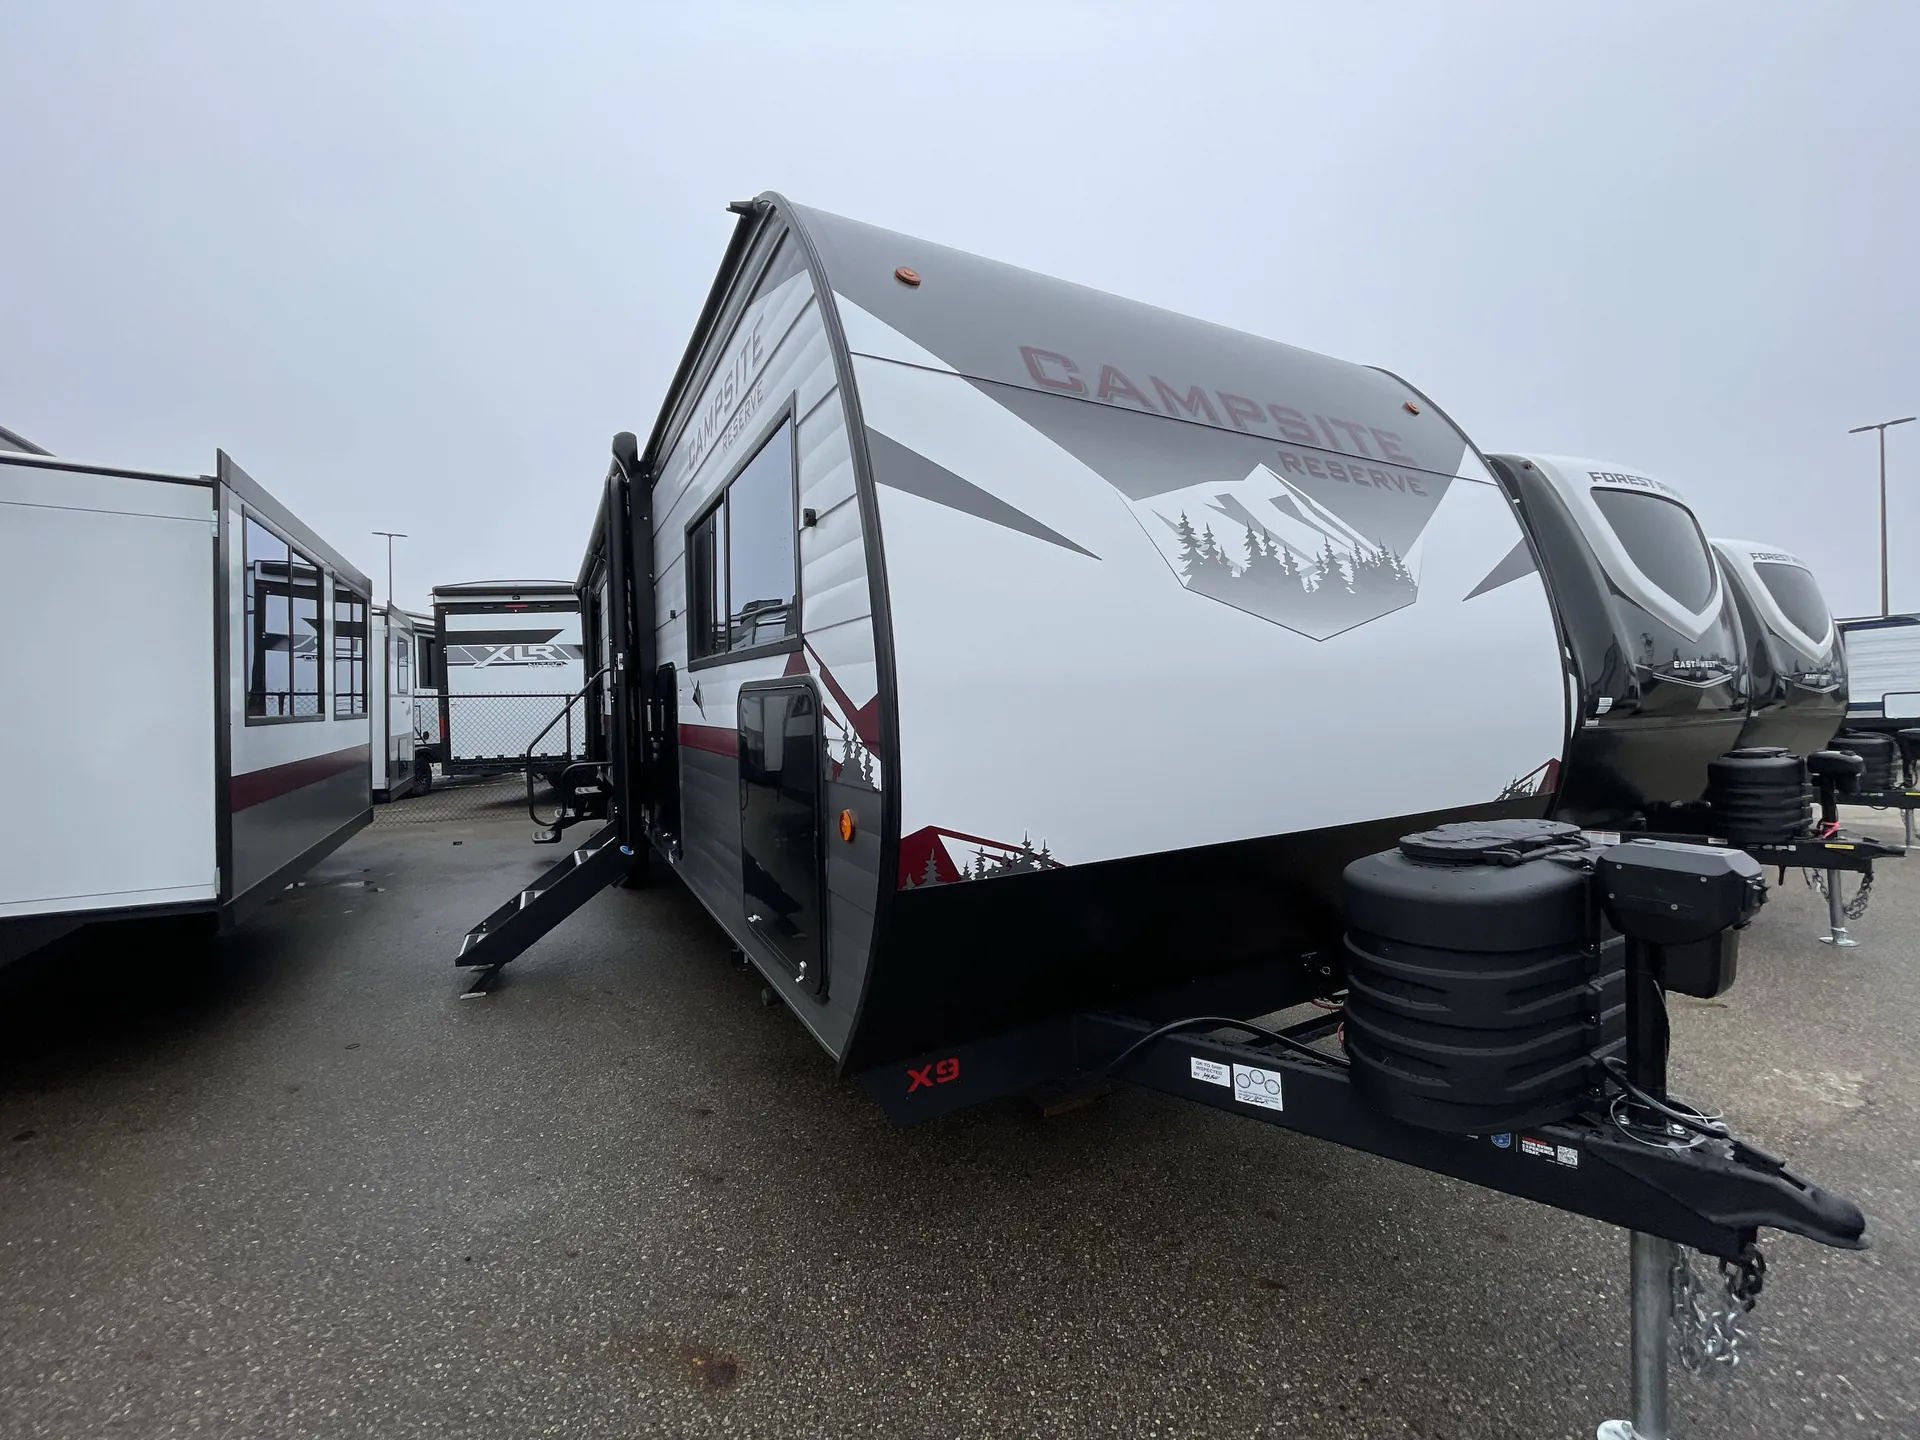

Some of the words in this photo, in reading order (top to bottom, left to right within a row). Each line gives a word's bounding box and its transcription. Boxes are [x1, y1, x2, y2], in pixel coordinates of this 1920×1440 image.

[685, 313, 764, 471] CAMPSITE
[1018, 345, 1417, 464] CAMPSITE
[722, 379, 764, 453] RESERVE
[1275, 449, 1429, 497] RESERVE
[1586, 472, 1655, 488] FOREST
[1749, 552, 1791, 562] FOREST
[474, 645, 557, 669] XLR
[1673, 660, 1695, 668] EAST
[907, 1057, 959, 1092] X9
